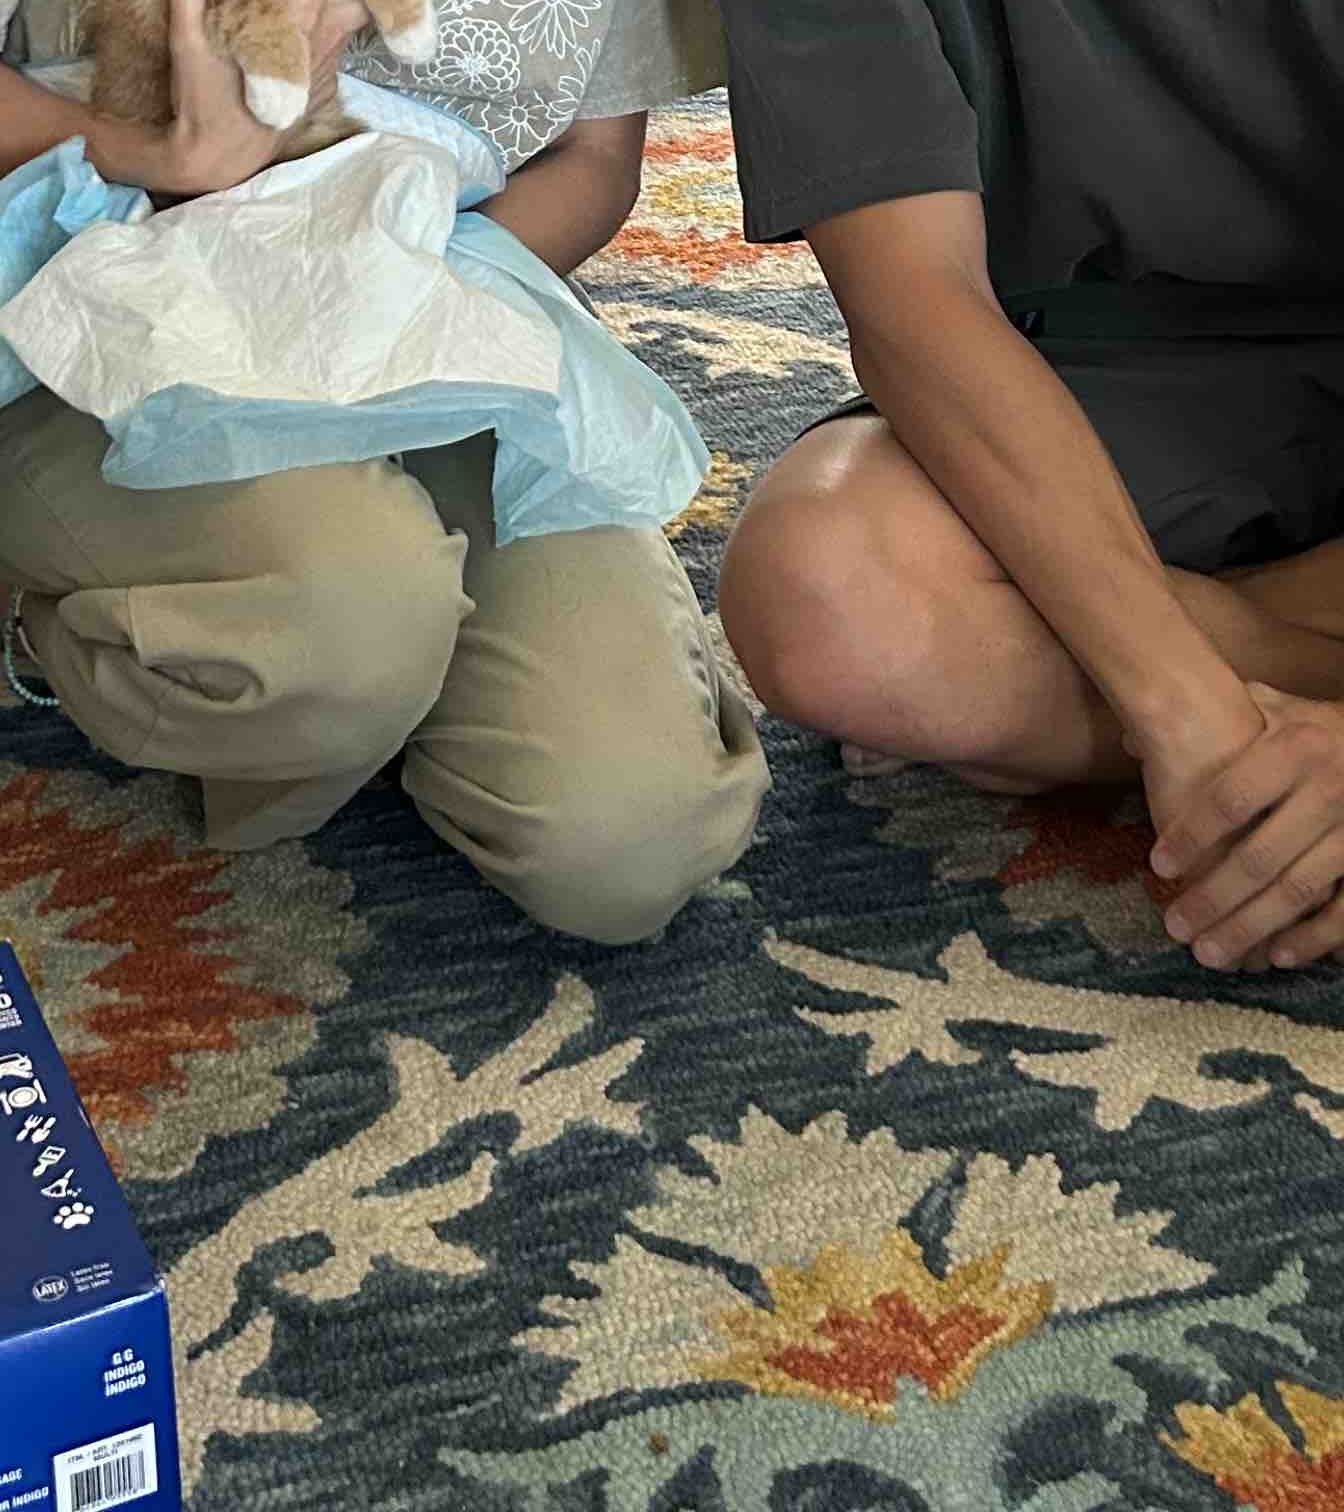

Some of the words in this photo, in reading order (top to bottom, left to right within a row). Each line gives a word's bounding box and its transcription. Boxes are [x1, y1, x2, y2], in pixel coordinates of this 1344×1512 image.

[112, 1352, 122, 1365] G
[123, 1348, 133, 1362] G
[104, 1359, 145, 1381] INDIGO
